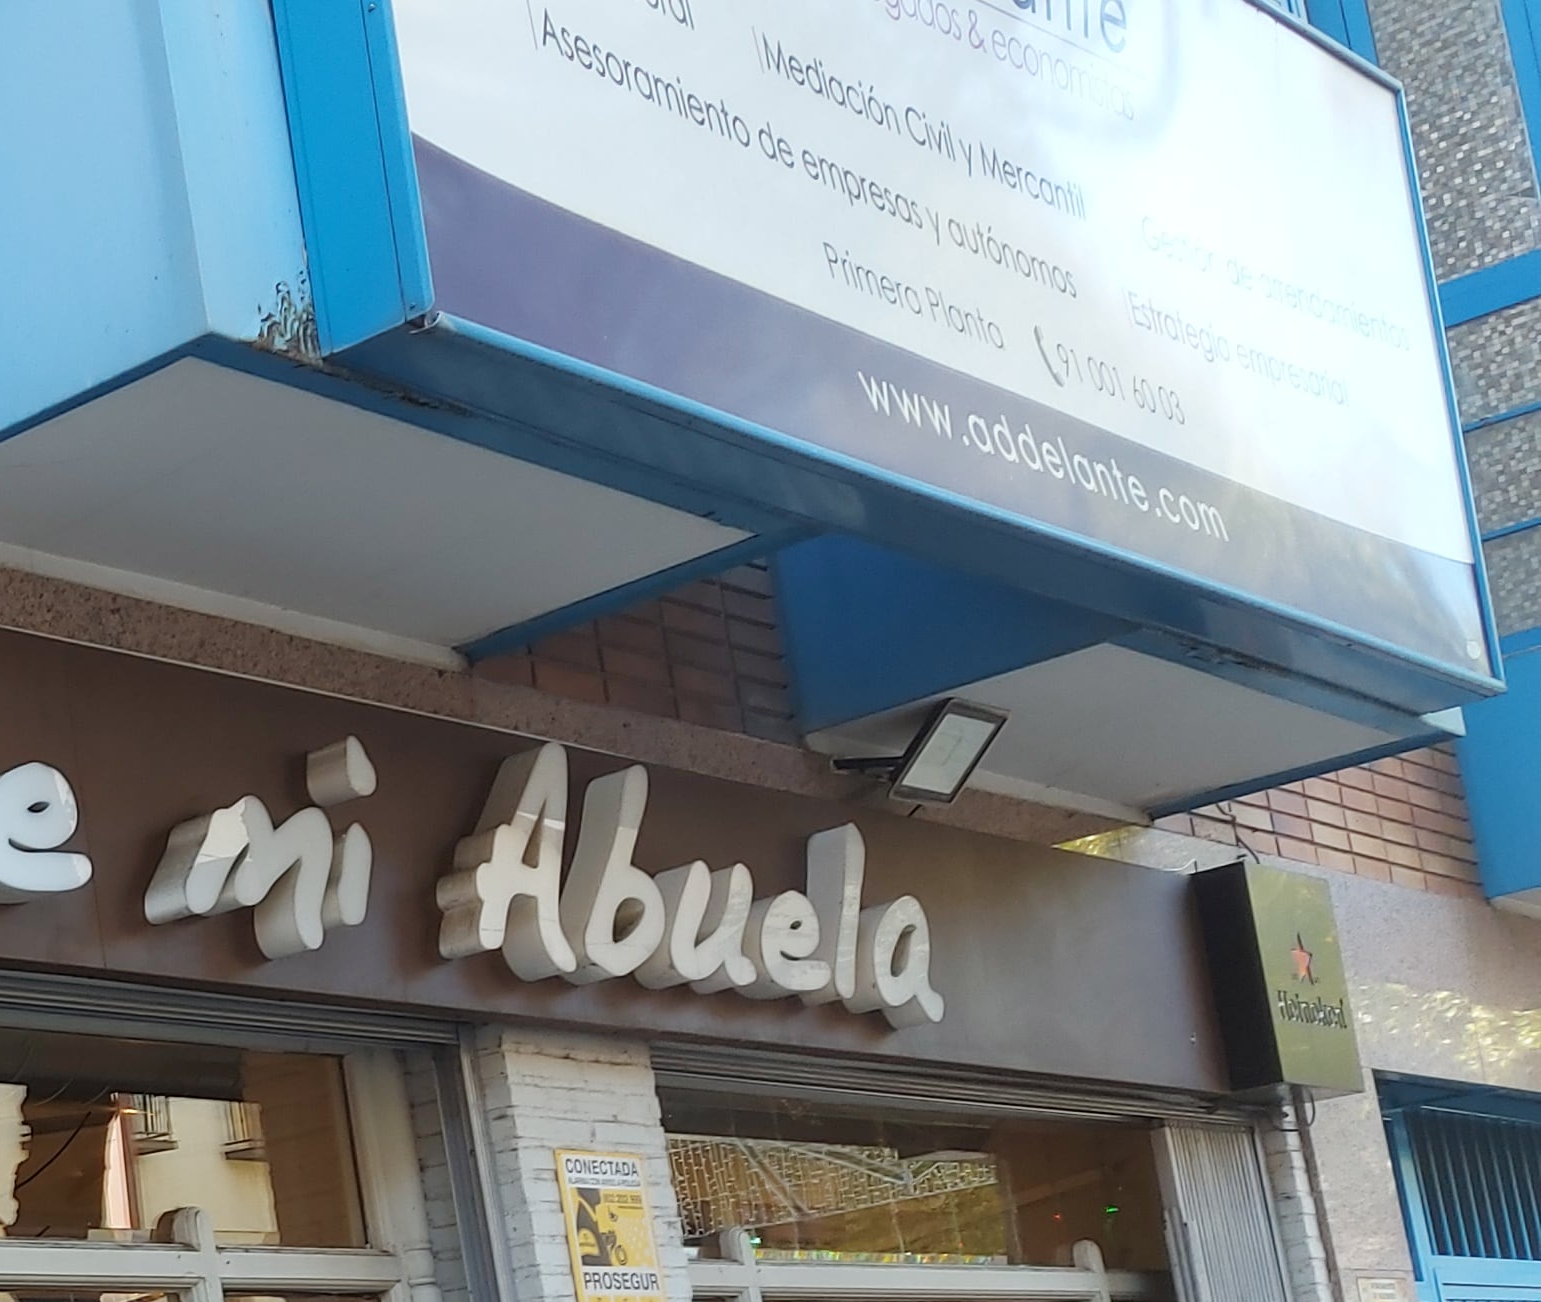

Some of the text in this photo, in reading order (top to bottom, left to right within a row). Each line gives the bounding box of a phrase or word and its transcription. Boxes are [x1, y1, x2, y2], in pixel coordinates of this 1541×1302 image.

[542, 7, 1078, 299] Asesoramiento de empresas y autónomos
[761, 32, 1087, 220] Mediación Civil y Mercantil
[823, 241, 923, 317] Primera
[925, 286, 1006, 351] Planta
[1127, 289, 1231, 363] Estrategia
[857, 370, 1230, 543] www.addelante.com
[143, 733, 378, 960] mi
[437, 740, 946, 1031] Abuela
[1277, 990, 1348, 1029] Heineken
[565, 1158, 639, 1177] CONECTADA
[583, 1271, 661, 1291] PROSEGUR
